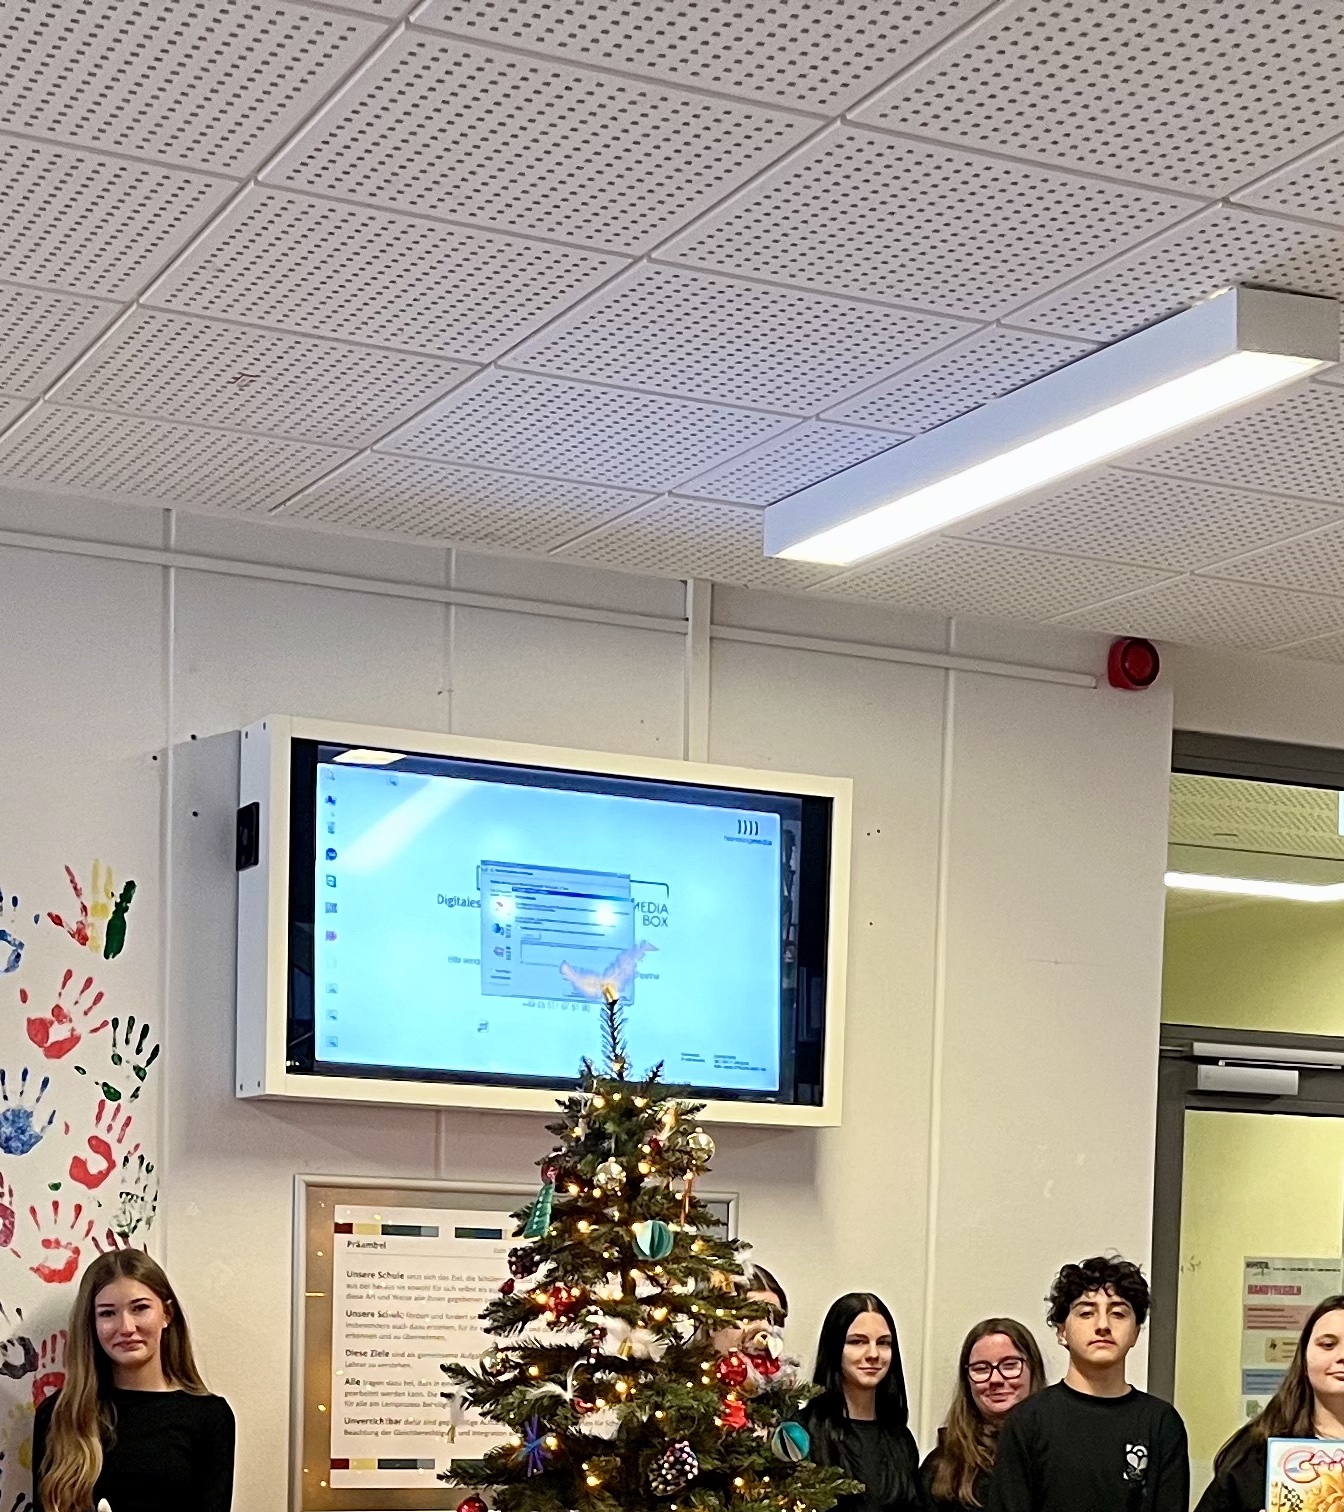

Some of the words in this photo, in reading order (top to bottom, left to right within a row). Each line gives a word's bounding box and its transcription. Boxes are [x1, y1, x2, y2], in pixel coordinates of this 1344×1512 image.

[642, 914, 669, 928] BOX
[346, 1270, 375, 1279] Unsere
[377, 1271, 405, 1280] Schule
[345, 1309, 375, 1319] Unsere
[345, 1349, 368, 1358] Diese
[370, 1350, 390, 1358] Ziele
[344, 1378, 361, 1386] Alle
